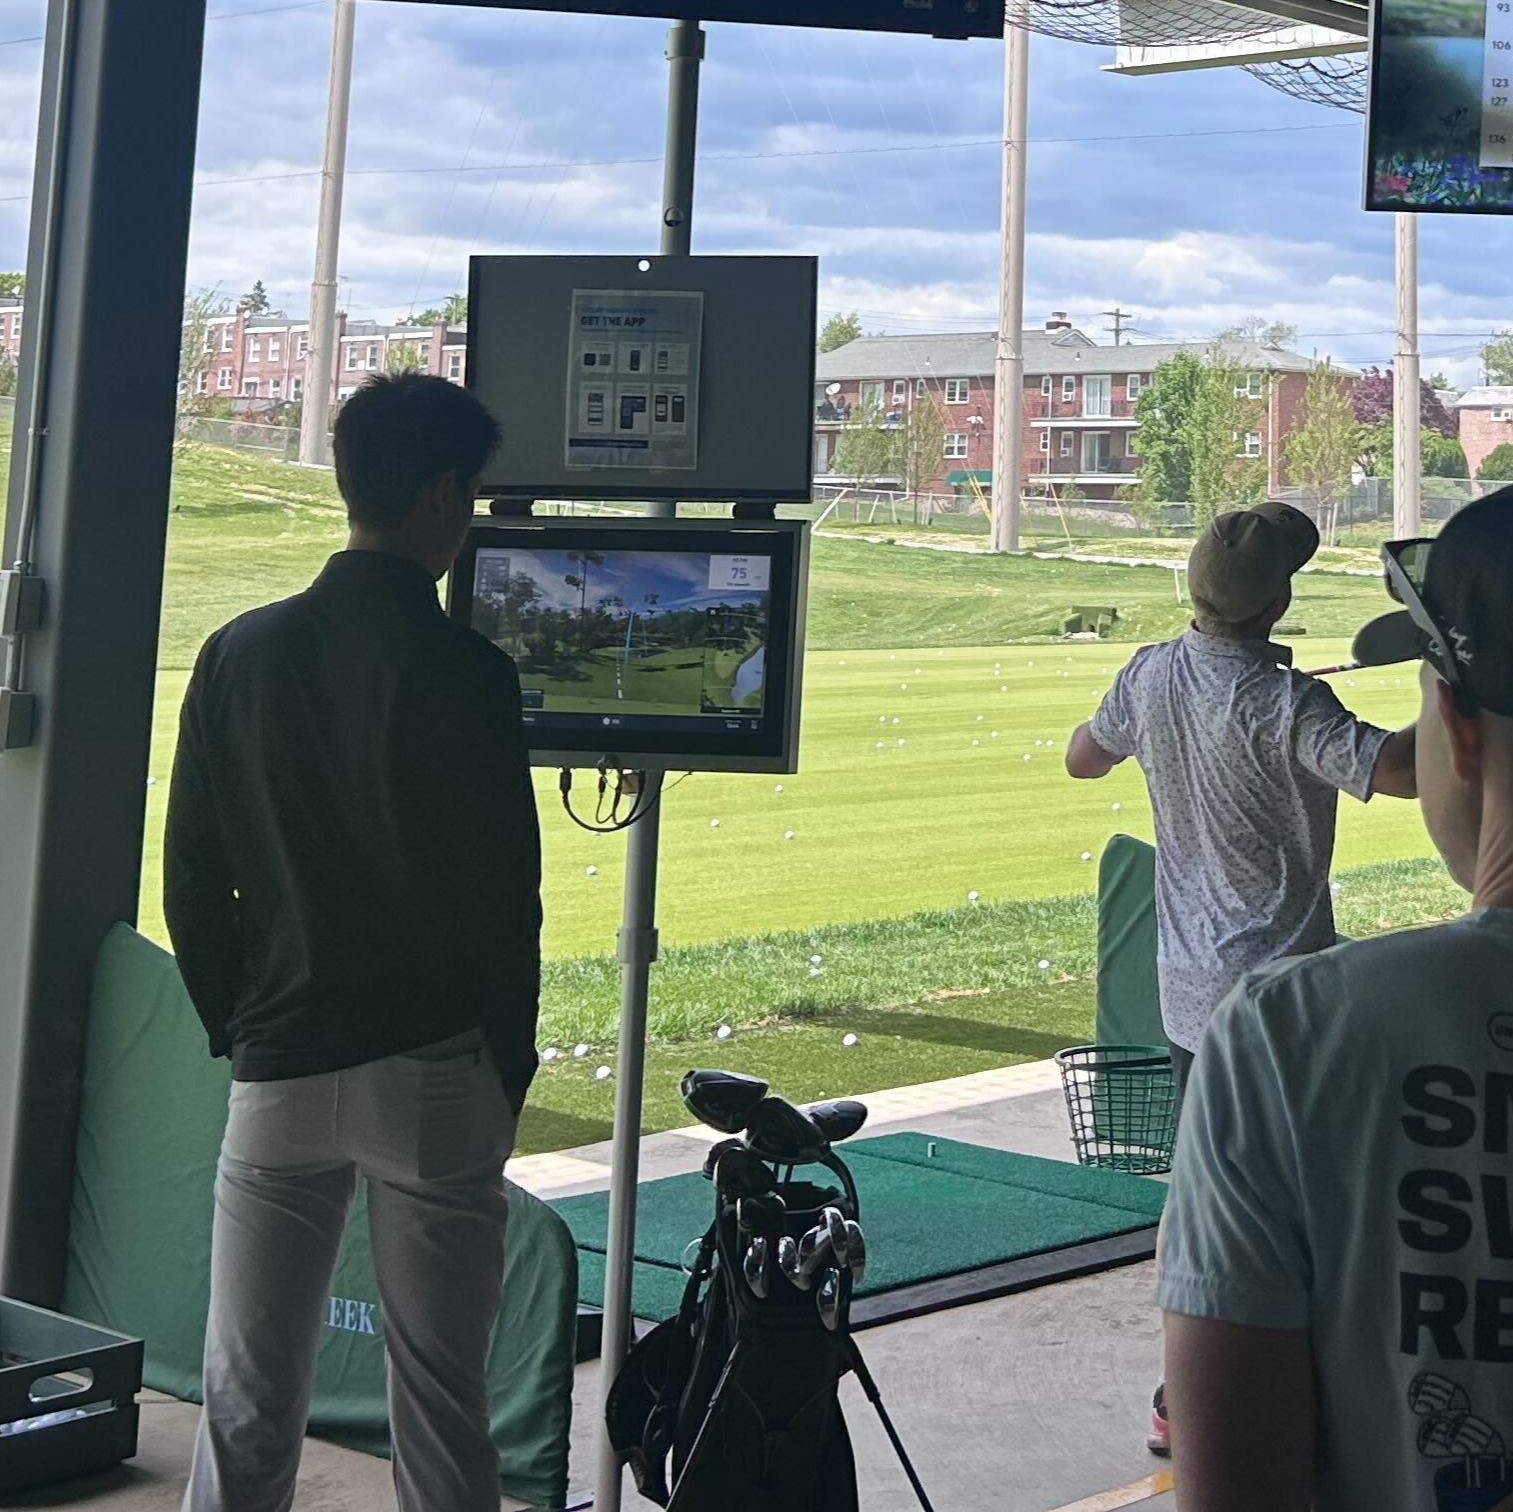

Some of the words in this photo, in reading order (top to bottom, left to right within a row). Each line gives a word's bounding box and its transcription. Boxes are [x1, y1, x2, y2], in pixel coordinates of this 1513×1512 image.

[1497, 3, 1510, 13] 93
[1492, 41, 1511, 50] 106
[1491, 78, 1509, 88] 123
[1491, 97, 1508, 106] 127
[580, 316, 599, 326] GET
[602, 316, 621, 327] THE
[624, 317, 646, 327] APP
[731, 567, 747, 579] 75
[324, 1296, 375, 1335] EEK
